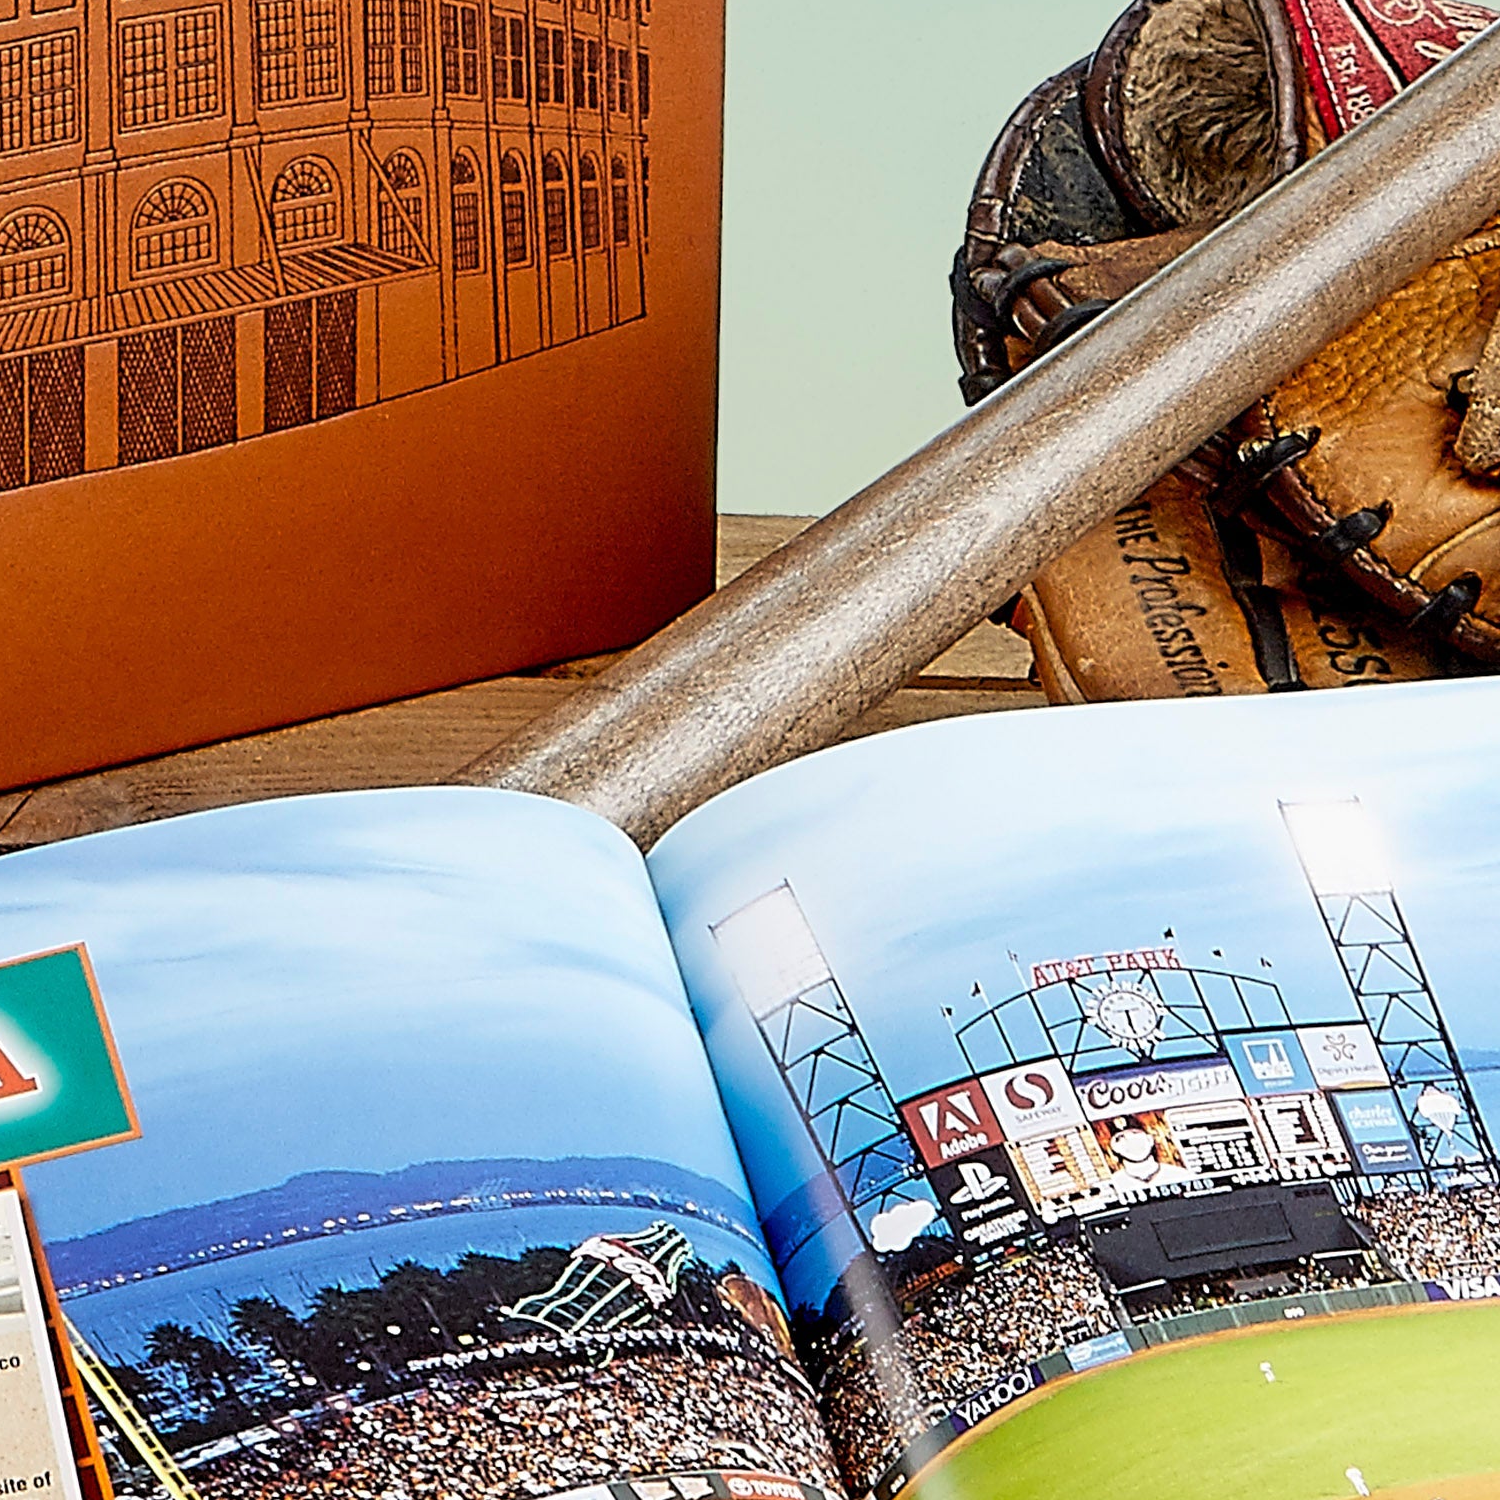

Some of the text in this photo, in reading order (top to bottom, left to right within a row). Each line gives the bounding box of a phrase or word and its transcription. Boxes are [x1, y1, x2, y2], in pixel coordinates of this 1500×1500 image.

[1030, 947, 1183, 990] AT&T PARK
[940, 1132, 989, 1160] Adobe
